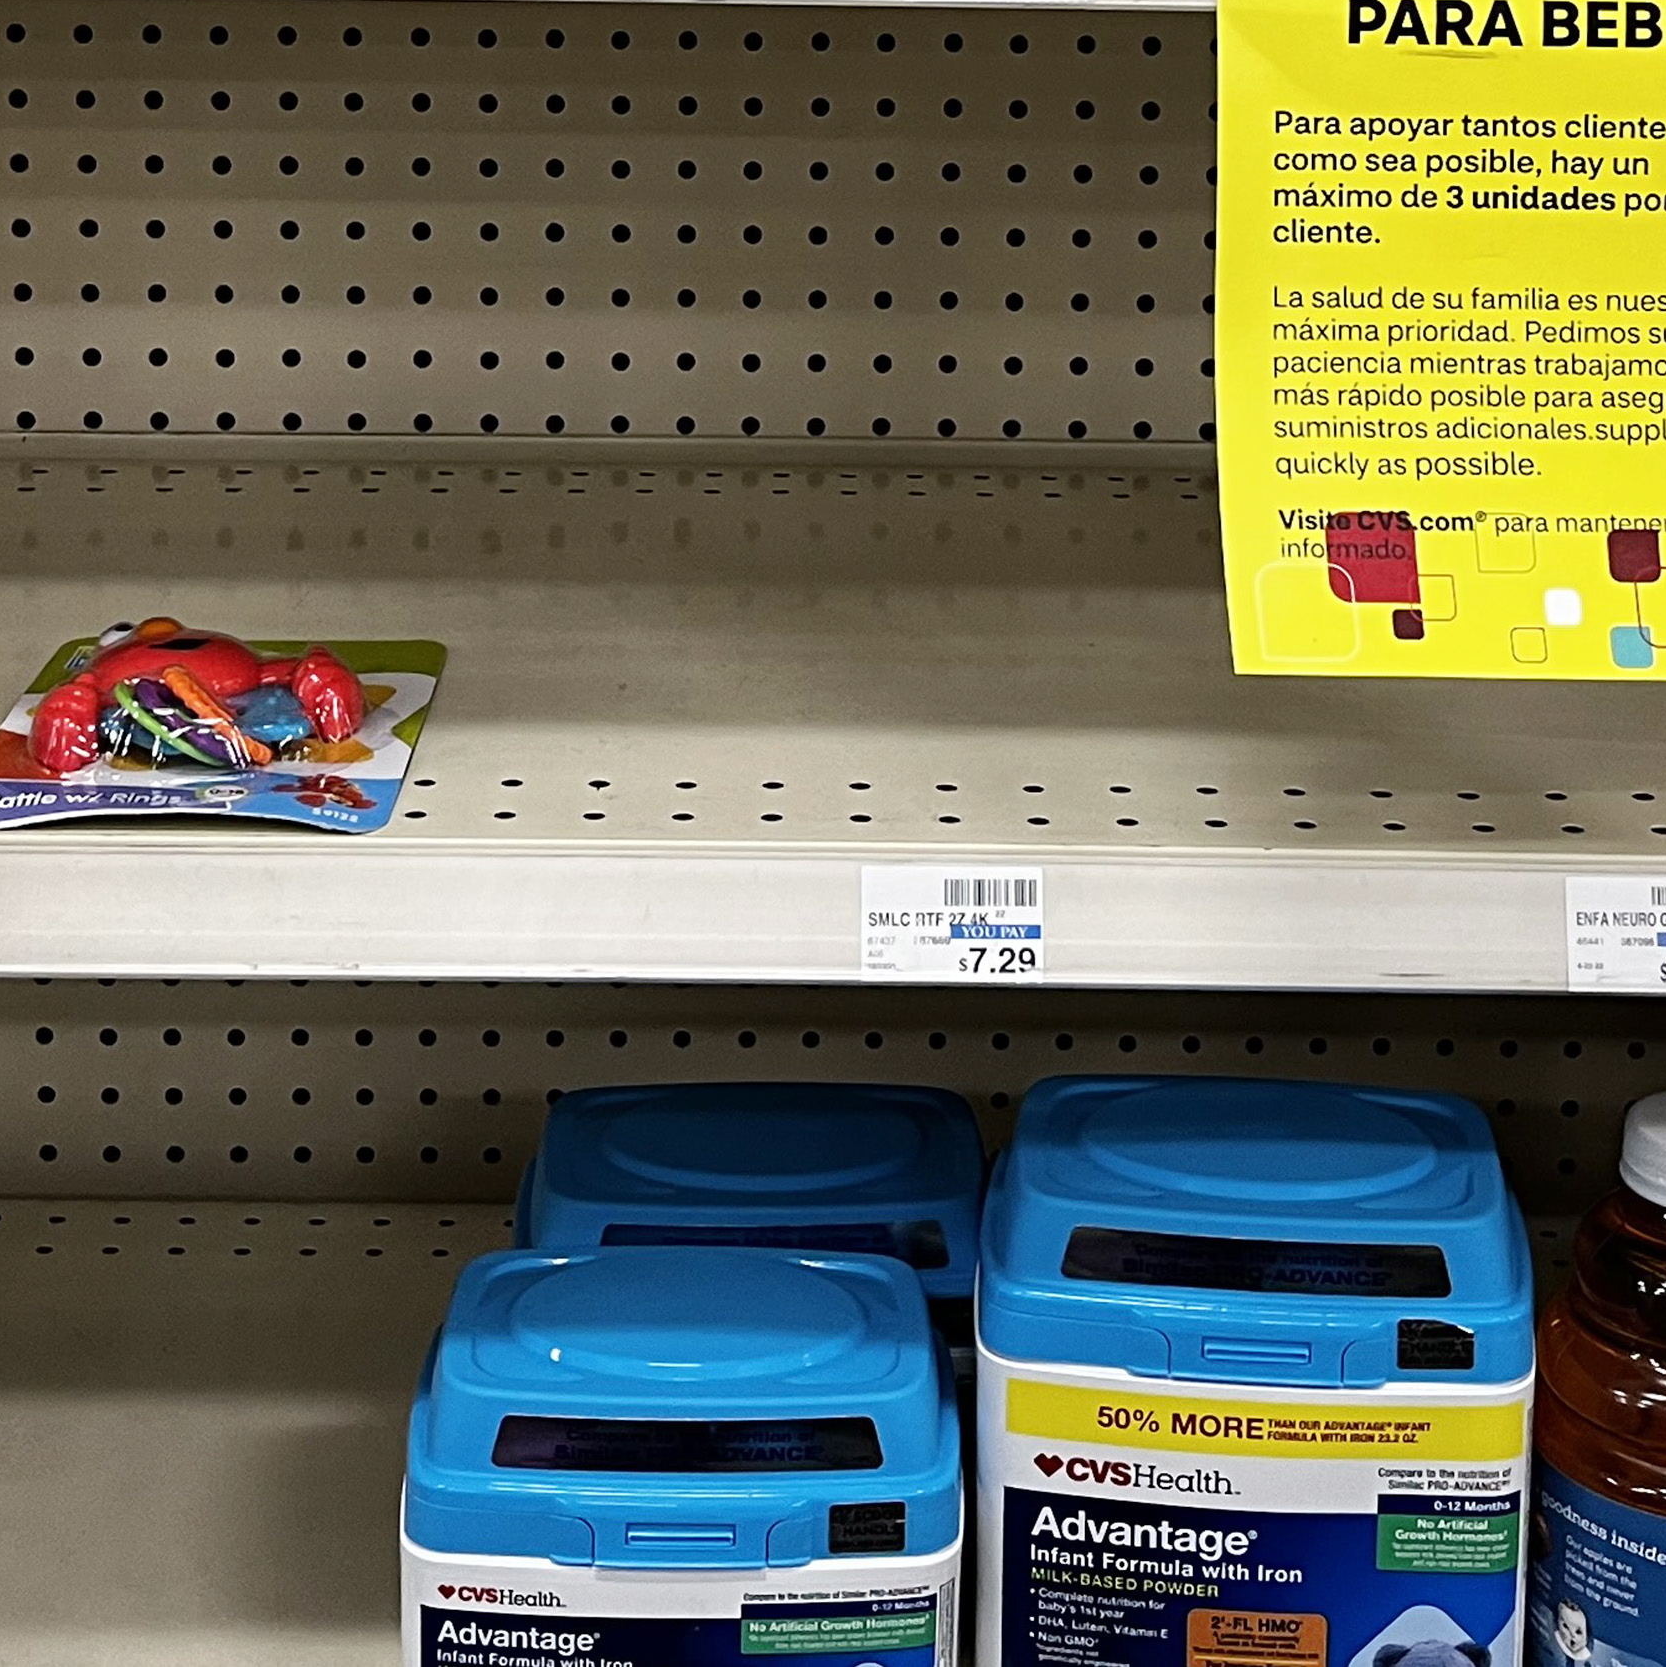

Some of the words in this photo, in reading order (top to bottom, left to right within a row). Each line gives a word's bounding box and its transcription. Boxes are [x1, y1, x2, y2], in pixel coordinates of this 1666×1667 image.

[1275, 110, 1342, 135] Para
[1349, 117, 1454, 142] apoyar
[1461, 114, 1557, 138] tantos
[1273, 153, 1357, 172] como
[1365, 153, 1417, 172] sea
[1426, 148, 1542, 178] posible,
[1551, 149, 1604, 181] hay
[1613, 157, 1649, 176] un
[1274, 181, 1392, 208] máximo
[1400, 183, 1438, 209] de
[1446, 185, 1464, 209] 3
[1472, 184, 1616, 211] unidades
[1273, 218, 1381, 244] cliente.
[1274, 286, 1304, 308] La
[1312, 285, 1383, 309] salud
[1391, 286, 1425, 310] de
[1433, 292, 1463, 310] su
[1471, 287, 1560, 311] familia
[1568, 294, 1598, 311] es
[1273, 317, 1380, 342] máxima
[1388, 320, 1516, 347] prioridad.
[1525, 320, 1640, 344] Pedimos
[1273, 351, 1402, 379] paciencia
[1410, 352, 1526, 375] mientras
[1274, 382, 1330, 406] más
[1338, 383, 1422, 411] rápido
[1431, 384, 1526, 412] posible
[1534, 390, 1593, 413] para
[1274, 417, 1428, 439] suministros
[1275, 452, 1369, 480] quickly
[1378, 458, 1407, 476] as
[1415, 451, 1542, 481] possible.
[1279, 510, 1351, 531] Visite
[1496, 515, 1548, 537] para
[1281, 539, 1412, 560] informado.
[1577, 912, 1609, 926] ENFA
[1613, 912, 1656, 926] NEURO
[959, 947, 1035, 973] $7.29
[1097, 1405, 1160, 1433] 50%
[1171, 1413, 1264, 1440] MORE
[1030, 1545, 1094, 1568] Infant
[1103, 1553, 1194, 1578] Formula
[1202, 1561, 1250, 1581] with
[1258, 1564, 1303, 1583] Iron
